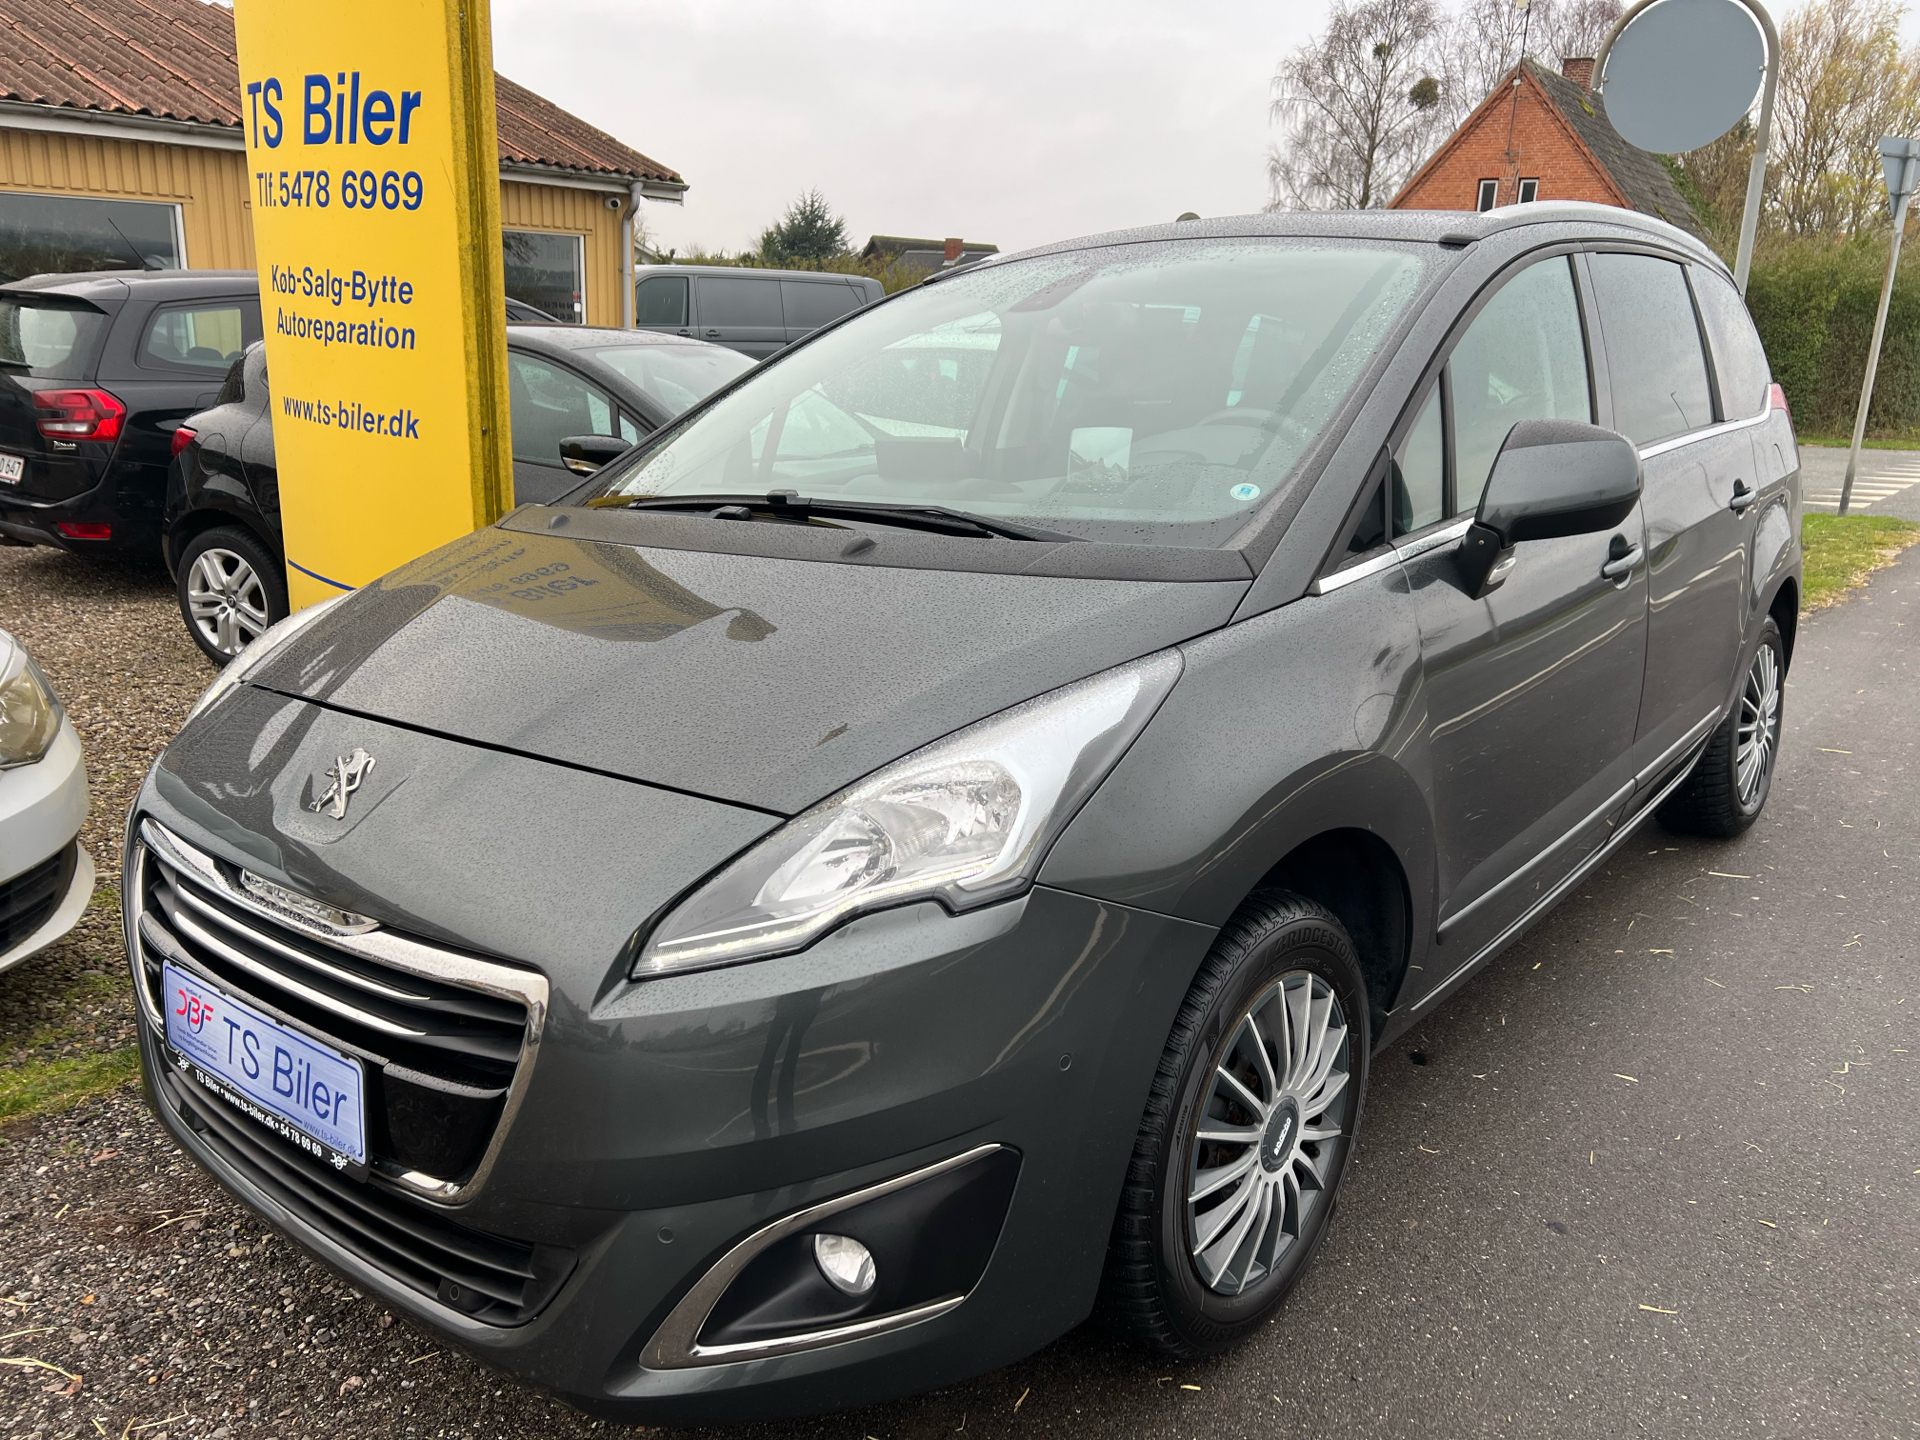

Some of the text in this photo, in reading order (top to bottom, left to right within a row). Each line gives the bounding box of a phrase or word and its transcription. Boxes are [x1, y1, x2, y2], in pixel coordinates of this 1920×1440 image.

[247, 71, 422, 149] TS Biler
[341, 170, 424, 211] 6969
[271, 264, 414, 308] Køb-Salg-Bytte
[277, 306, 415, 350] Autoreparation
[283, 395, 420, 440] www.ts-biler.dk
[223, 1016, 348, 1126] TS Biler
[195, 1069, 322, 1157] TS Biler www.ts-biler.dk 54 78 69 69
[303, 1120, 357, 1158] www.ts-biler.dk
